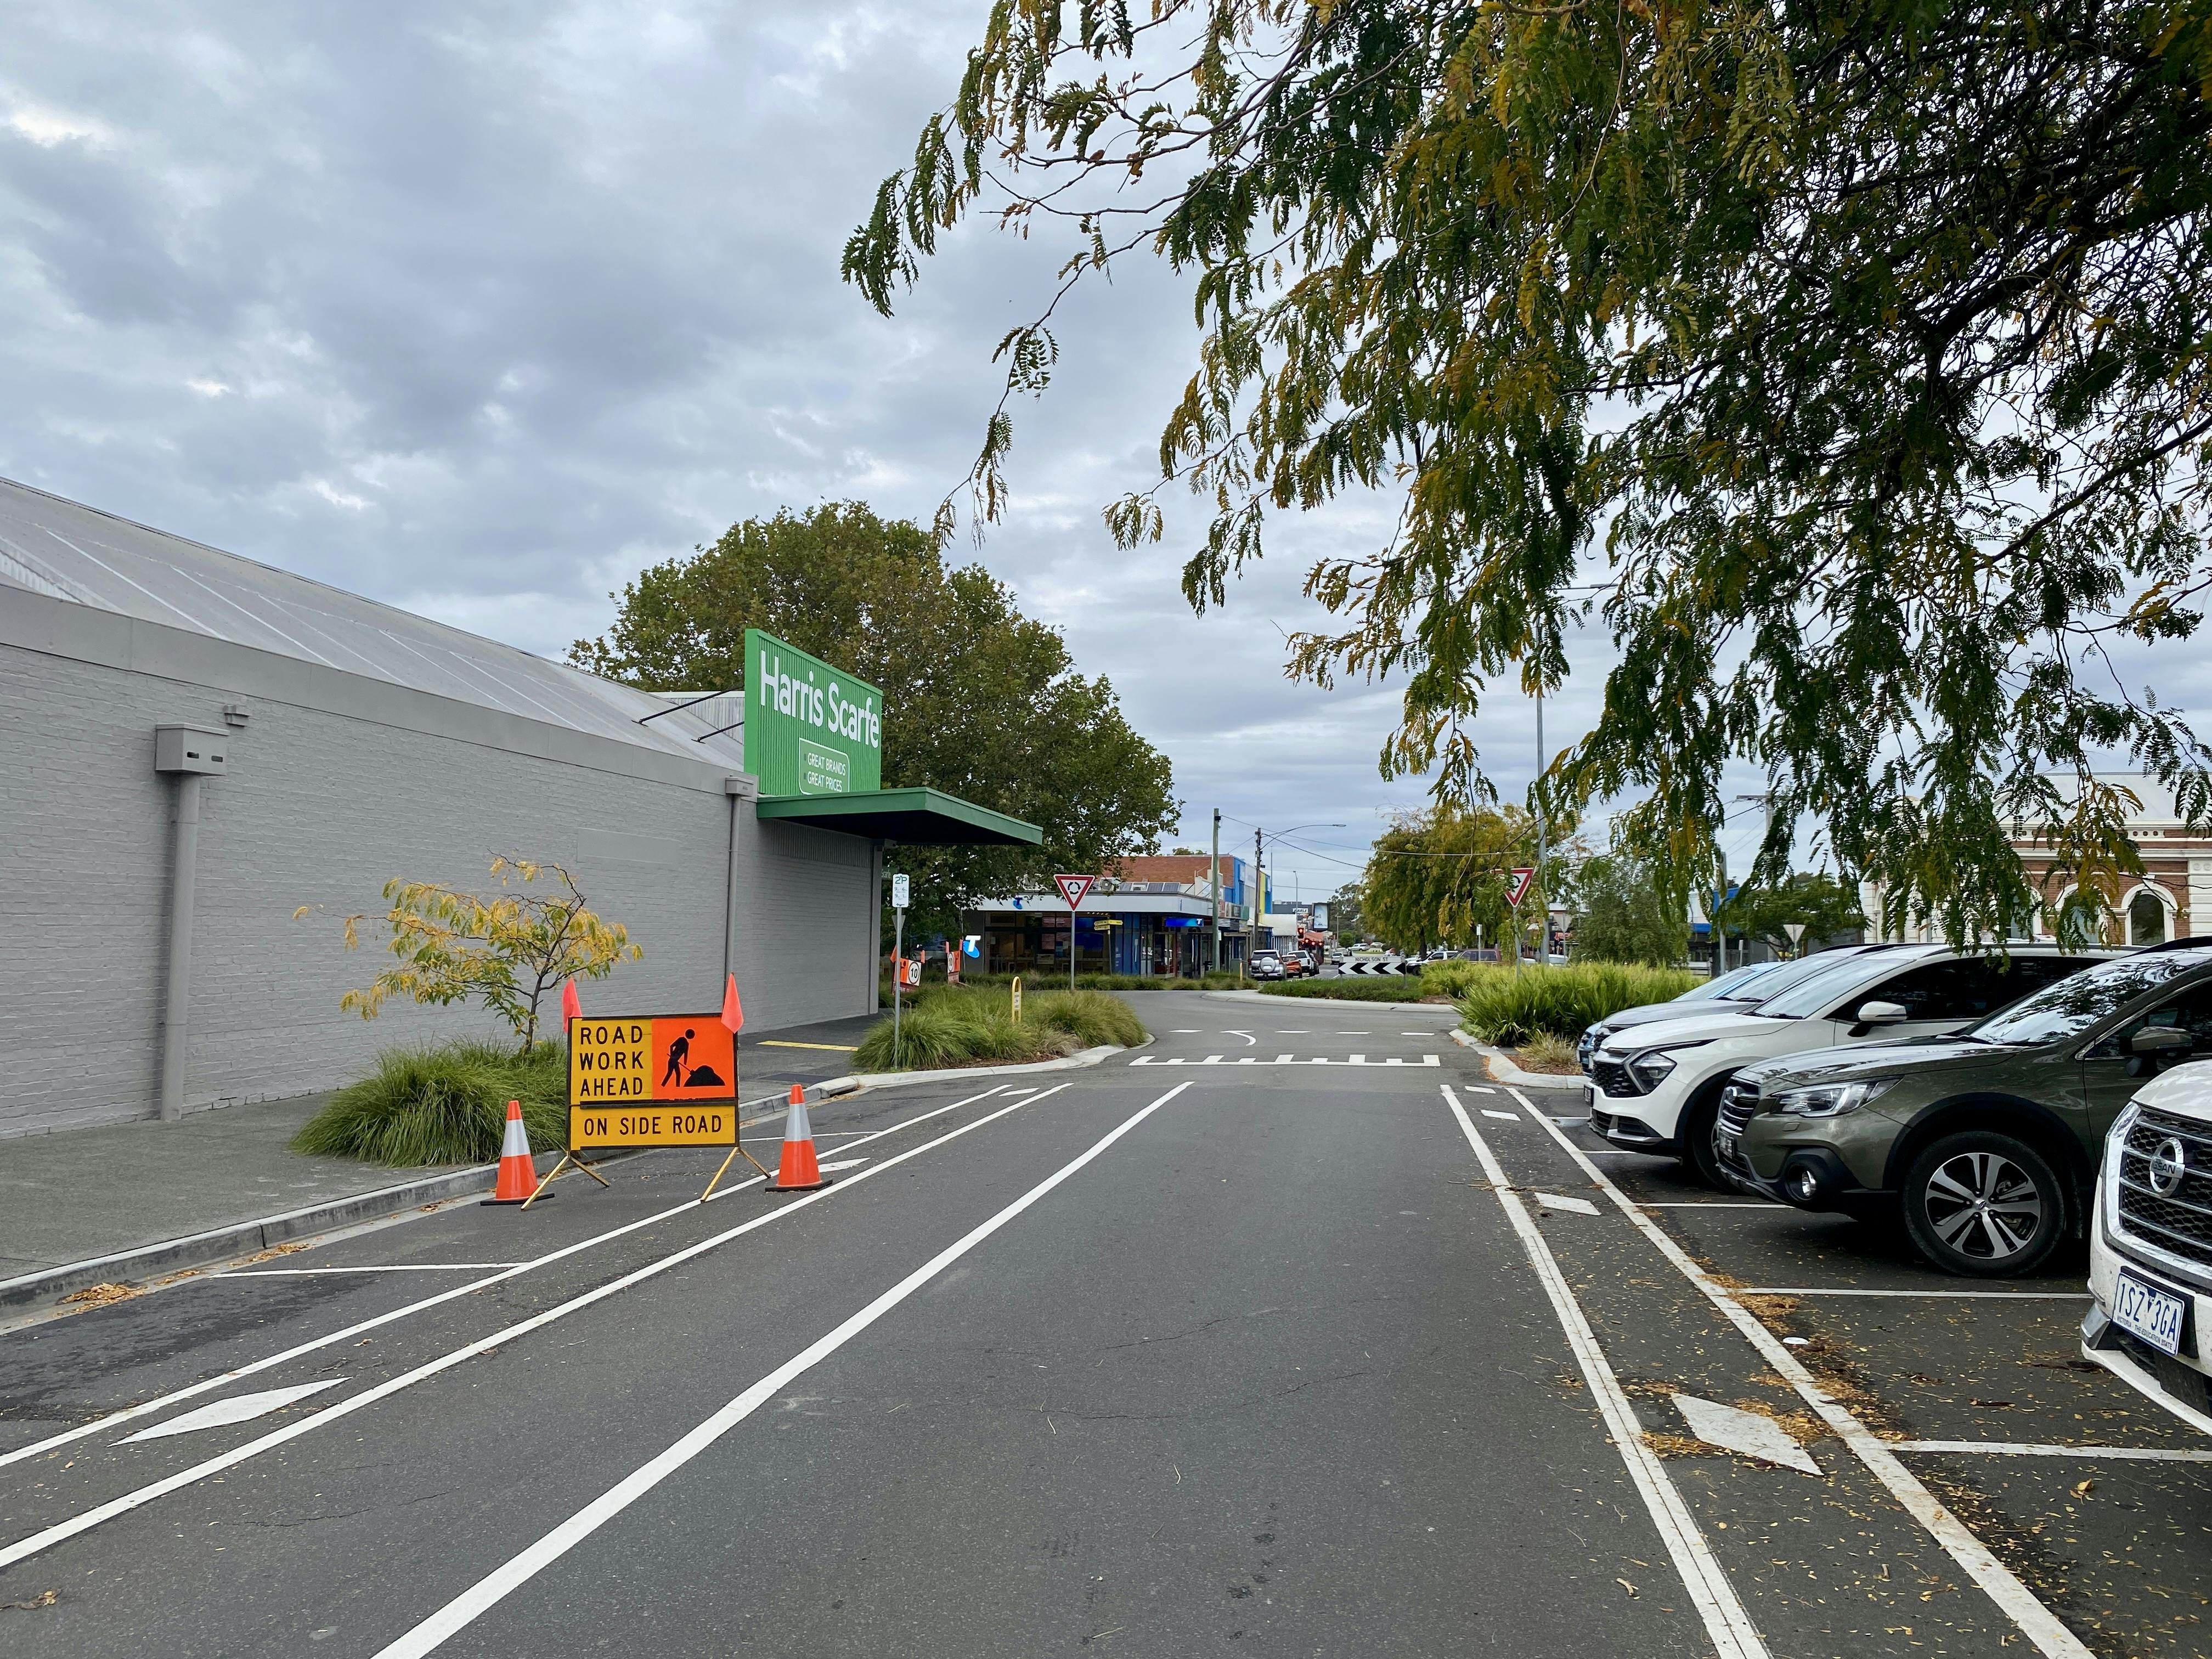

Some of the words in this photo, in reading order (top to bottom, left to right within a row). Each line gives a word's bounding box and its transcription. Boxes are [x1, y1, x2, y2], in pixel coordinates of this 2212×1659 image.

[760, 650, 823, 727] Harris
[828, 682, 879, 748] Scarfe
[808, 752, 825, 769] GREAT
[826, 758, 846, 776] BRANDS
[807, 771, 825, 787] GREAT
[826, 776, 842, 792] PRICES
[895, 876, 907, 884] 2P
[911, 968, 918, 978] 10
[580, 1025, 643, 1045] ROAD
[579, 1051, 644, 1071] WORK
[580, 1077, 643, 1096] AHEAD
[584, 1118, 607, 1136] ON
[619, 1116, 662, 1135] SIDE
[673, 1115, 722, 1133] ROAD
[2161, 1339, 2173, 1350] STATE
